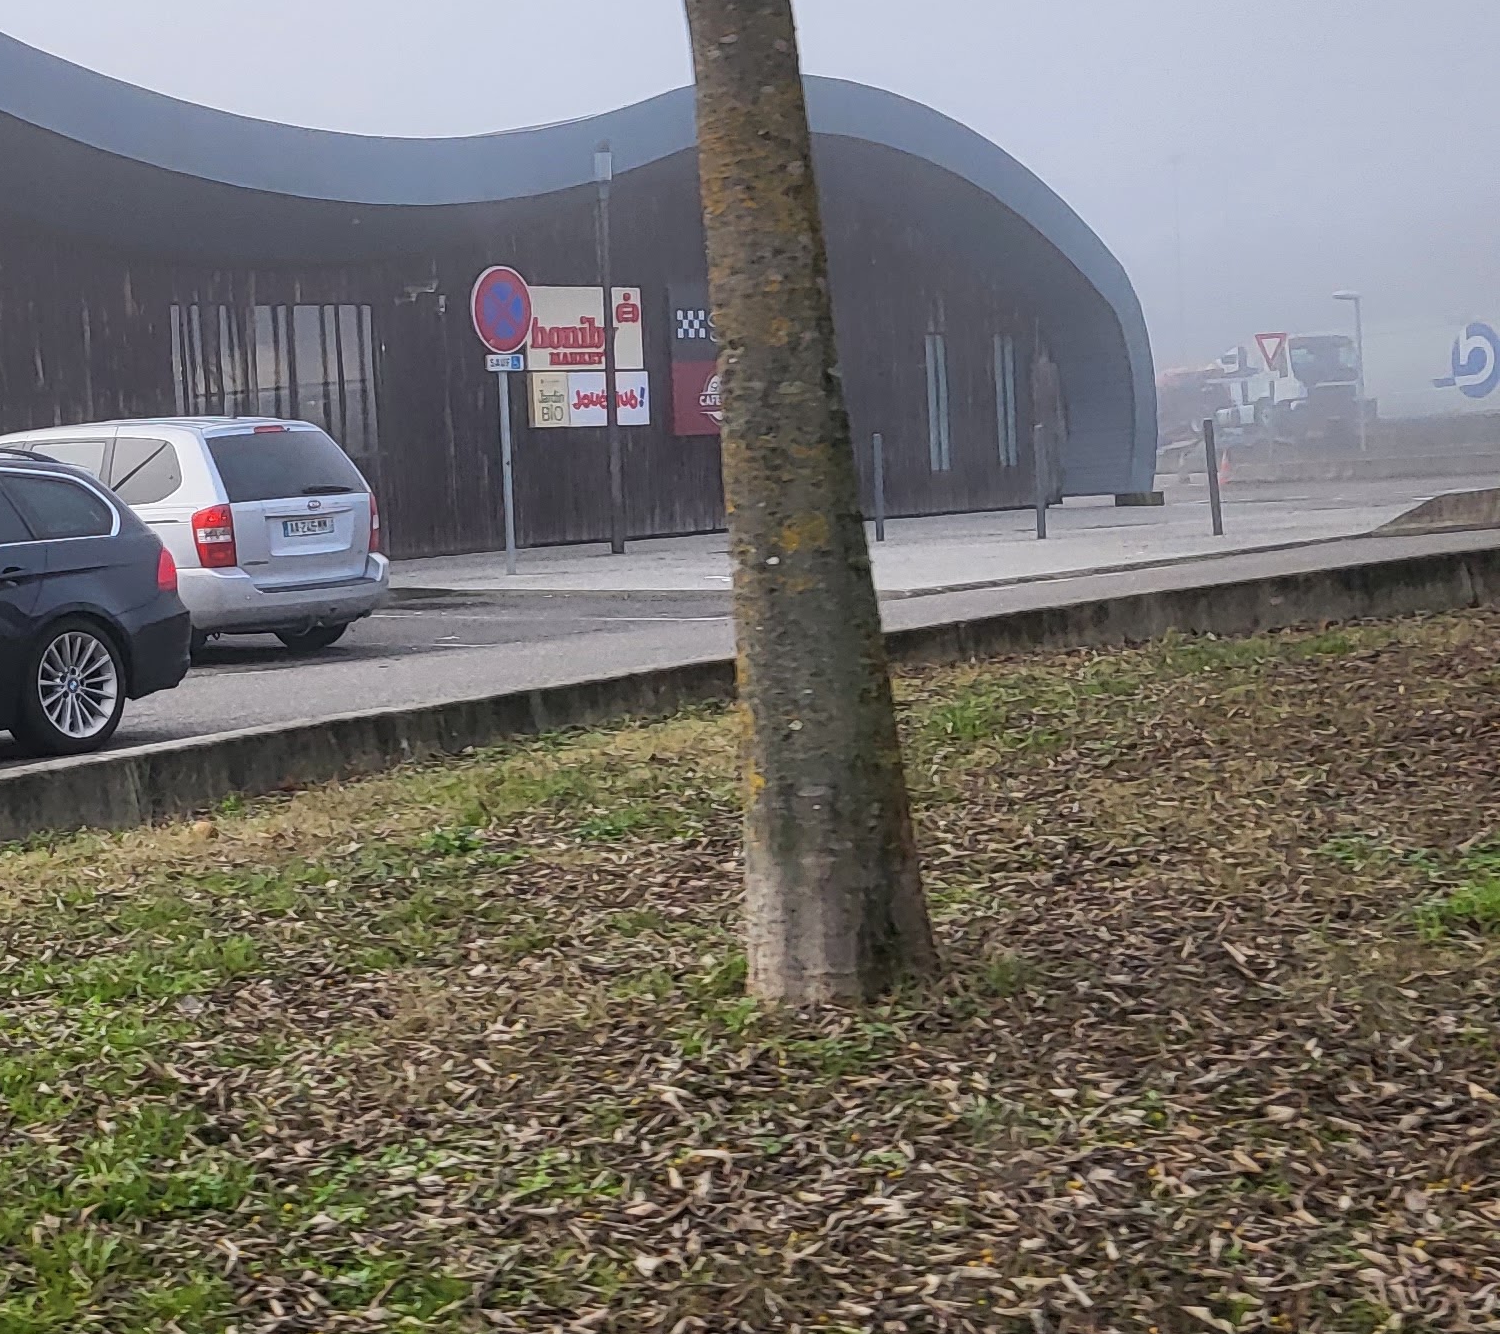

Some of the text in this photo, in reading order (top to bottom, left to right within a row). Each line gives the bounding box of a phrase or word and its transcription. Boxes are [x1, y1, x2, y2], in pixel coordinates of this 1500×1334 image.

[531, 315, 619, 349] honib
[490, 358, 510, 367] SAUF
[549, 352, 604, 365] MARKET
